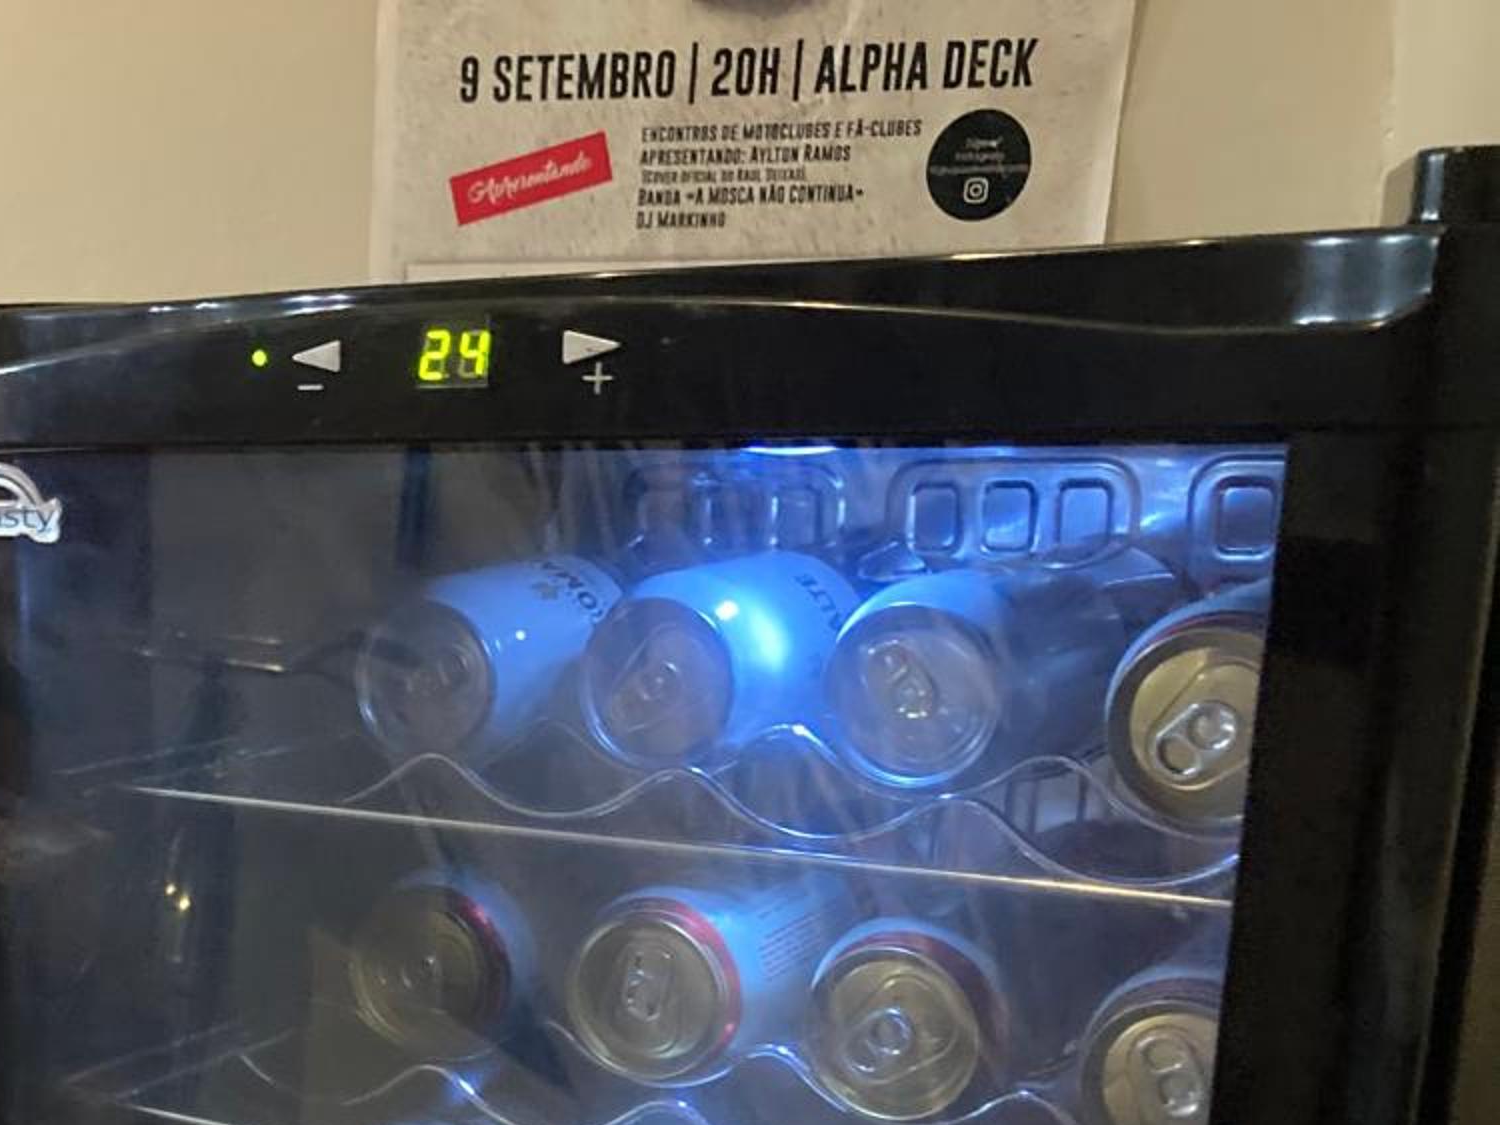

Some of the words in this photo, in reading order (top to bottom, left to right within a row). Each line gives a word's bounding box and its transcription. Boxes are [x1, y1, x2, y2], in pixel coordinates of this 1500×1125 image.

[460, 56, 479, 102] 9
[493, 50, 676, 102] SETEMBRO
[711, 47, 780, 96] 20H
[814, 42, 928, 93] ALPHA
[943, 38, 1038, 89] DECK
[721, 123, 738, 141] DE
[419, 329, 490, 380] 24
